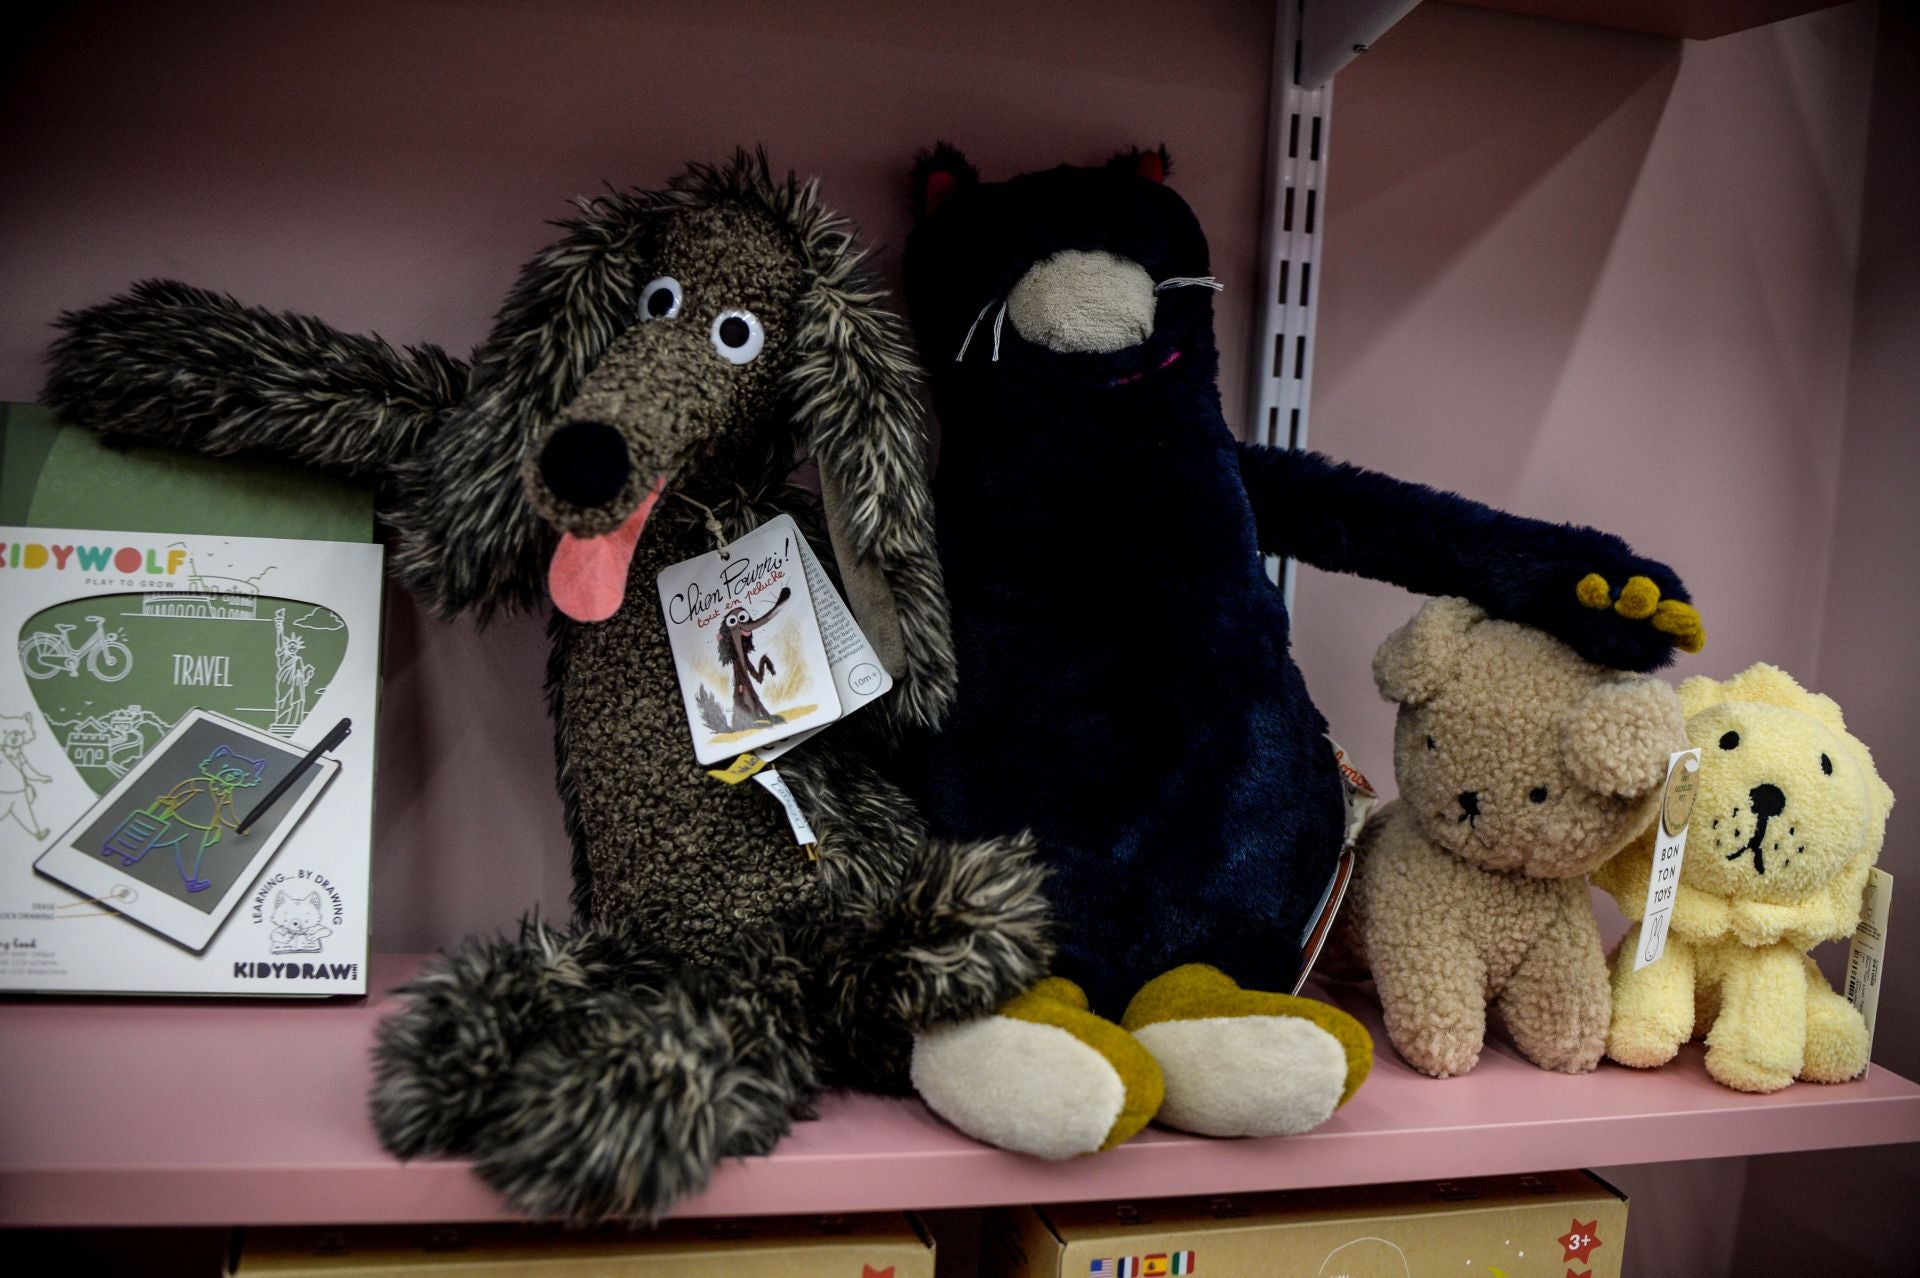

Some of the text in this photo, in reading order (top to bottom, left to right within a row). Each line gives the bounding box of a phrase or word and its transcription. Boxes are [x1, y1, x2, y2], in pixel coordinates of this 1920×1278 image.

[85, 578, 113, 586] PLAY
[140, 580, 174, 588] GROW
[669, 583, 724, 624] Chien
[720, 537, 789, 600] Pourri!
[697, 570, 785, 628] tout en peluche
[172, 654, 233, 687] TRAVEL
[1661, 844, 1680, 861] BON
[1658, 865, 1676, 882] TON
[298, 869, 314, 880] BY
[314, 874, 344, 926] DRAWING
[1654, 886, 1672, 904] TOYS
[234, 962, 352, 980] KIDYDRAW
[1568, 1234, 1591, 1251] 3+
